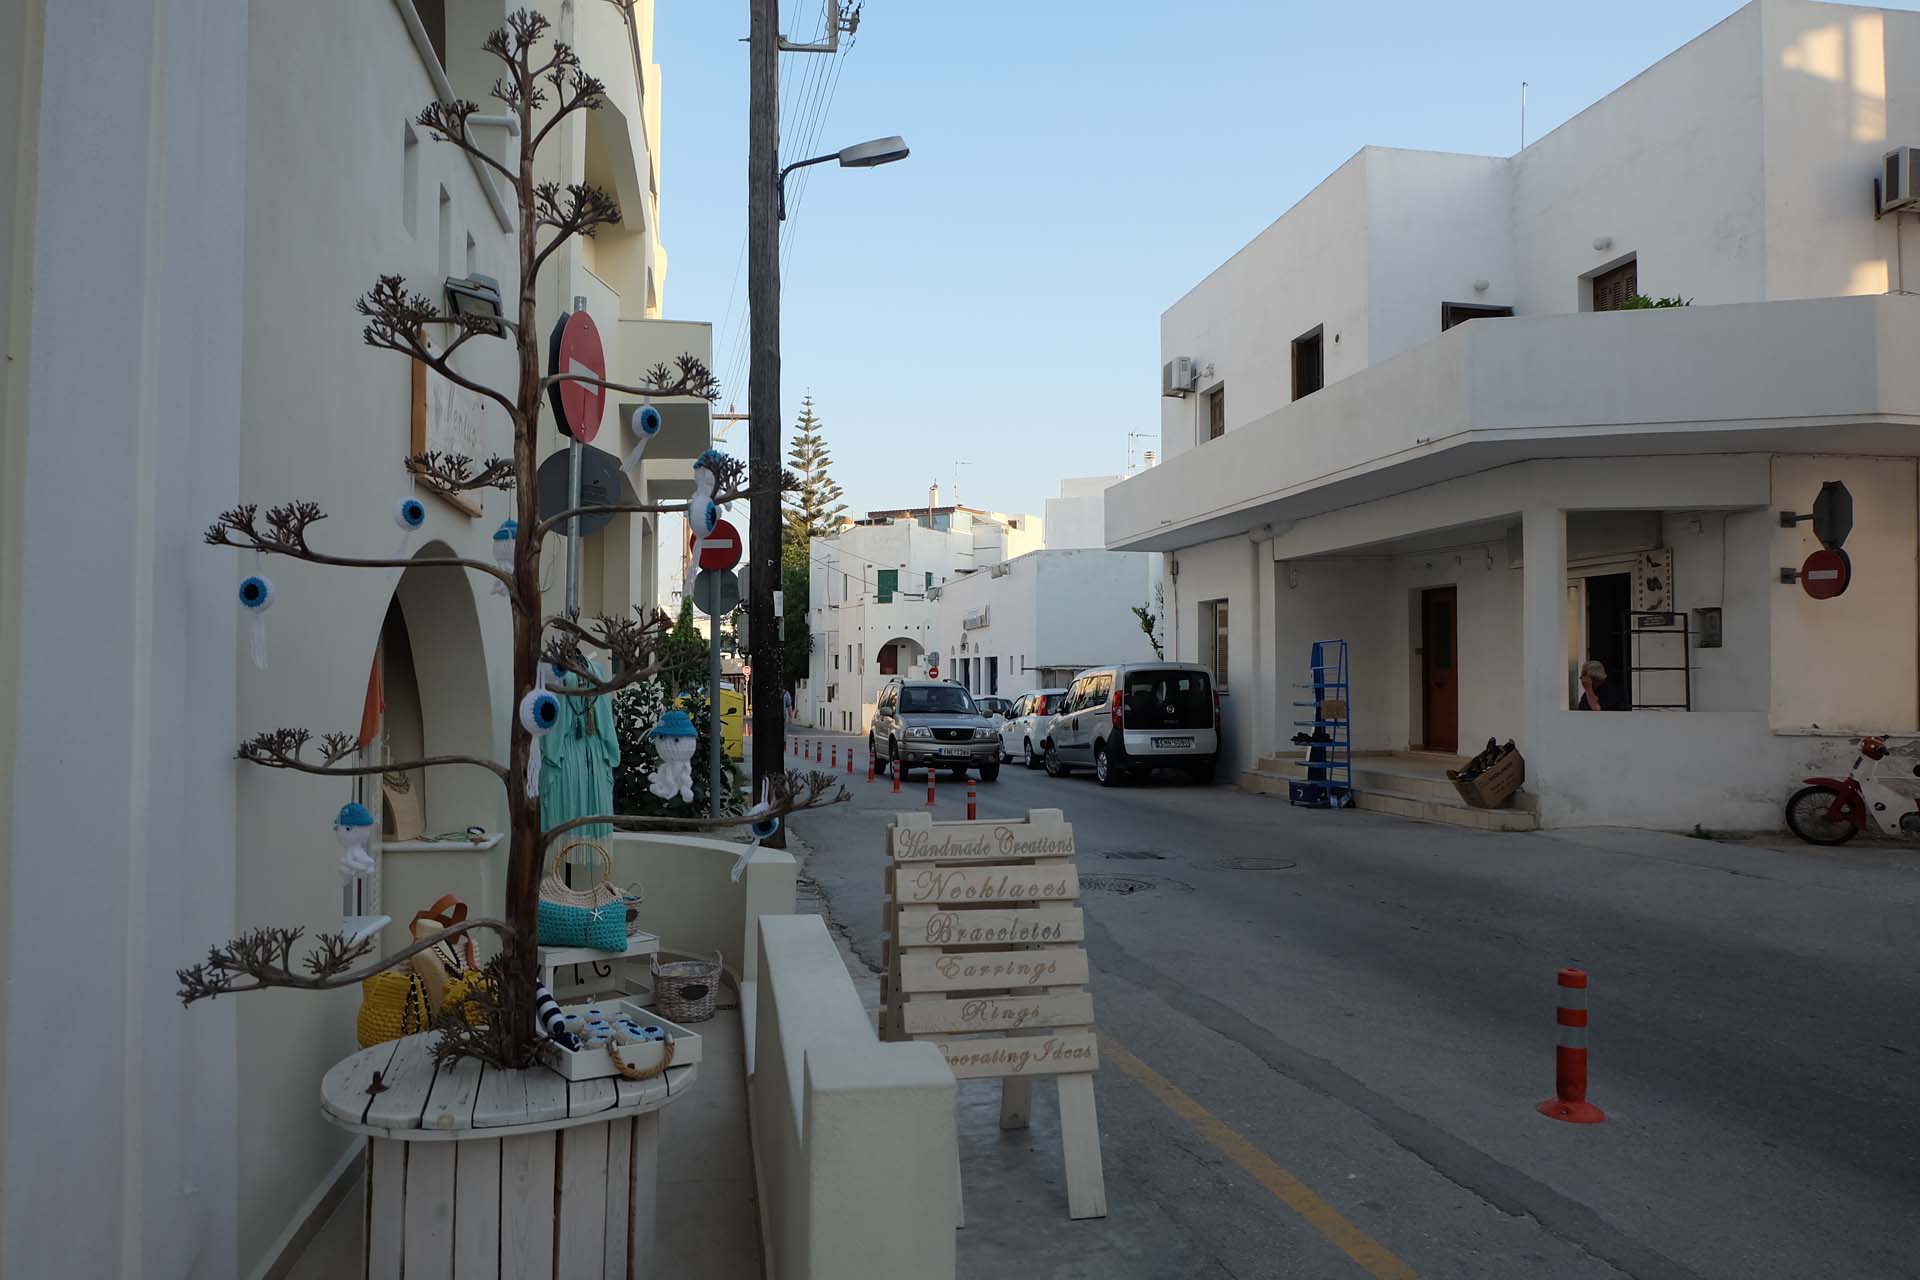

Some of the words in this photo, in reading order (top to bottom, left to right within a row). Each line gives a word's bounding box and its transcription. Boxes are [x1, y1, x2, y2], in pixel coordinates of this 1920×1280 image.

[897, 828, 992, 858] Handmade
[993, 826, 1073, 856] Creations
[912, 870, 1067, 901] Necklaces
[935, 955, 1057, 984] Earrings
[960, 999, 1040, 1027] Rings
[1033, 1038, 1092, 1062] Ideas
